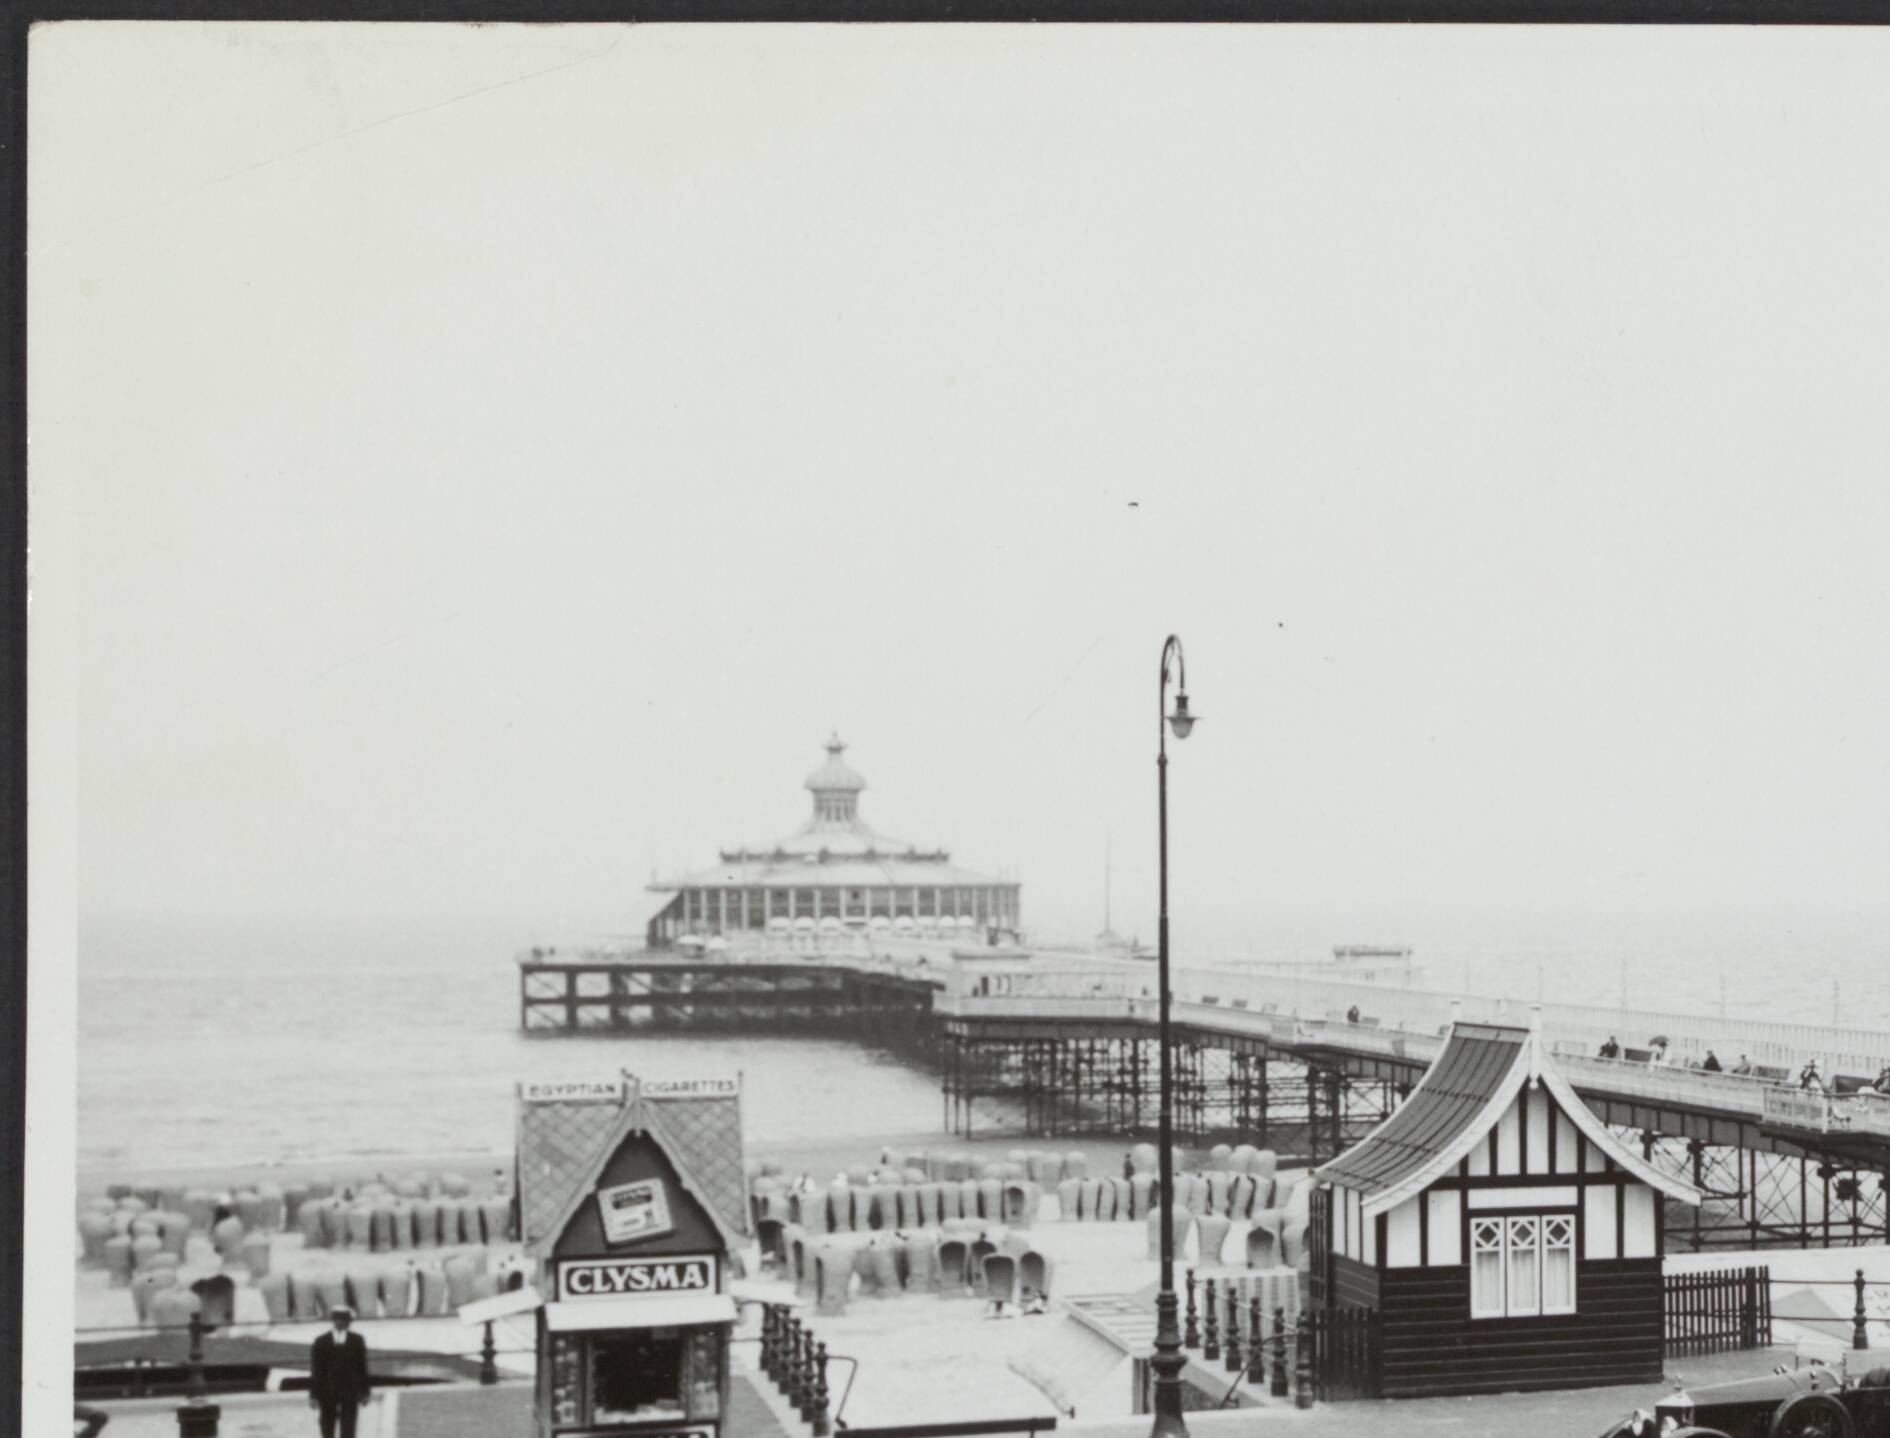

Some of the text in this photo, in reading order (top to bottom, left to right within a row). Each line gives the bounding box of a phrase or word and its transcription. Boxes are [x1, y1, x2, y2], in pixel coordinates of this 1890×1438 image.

[529, 1079, 736, 1098] EGYPTIAN CIGARETTES
[569, 1263, 706, 1294] CLYSMA
